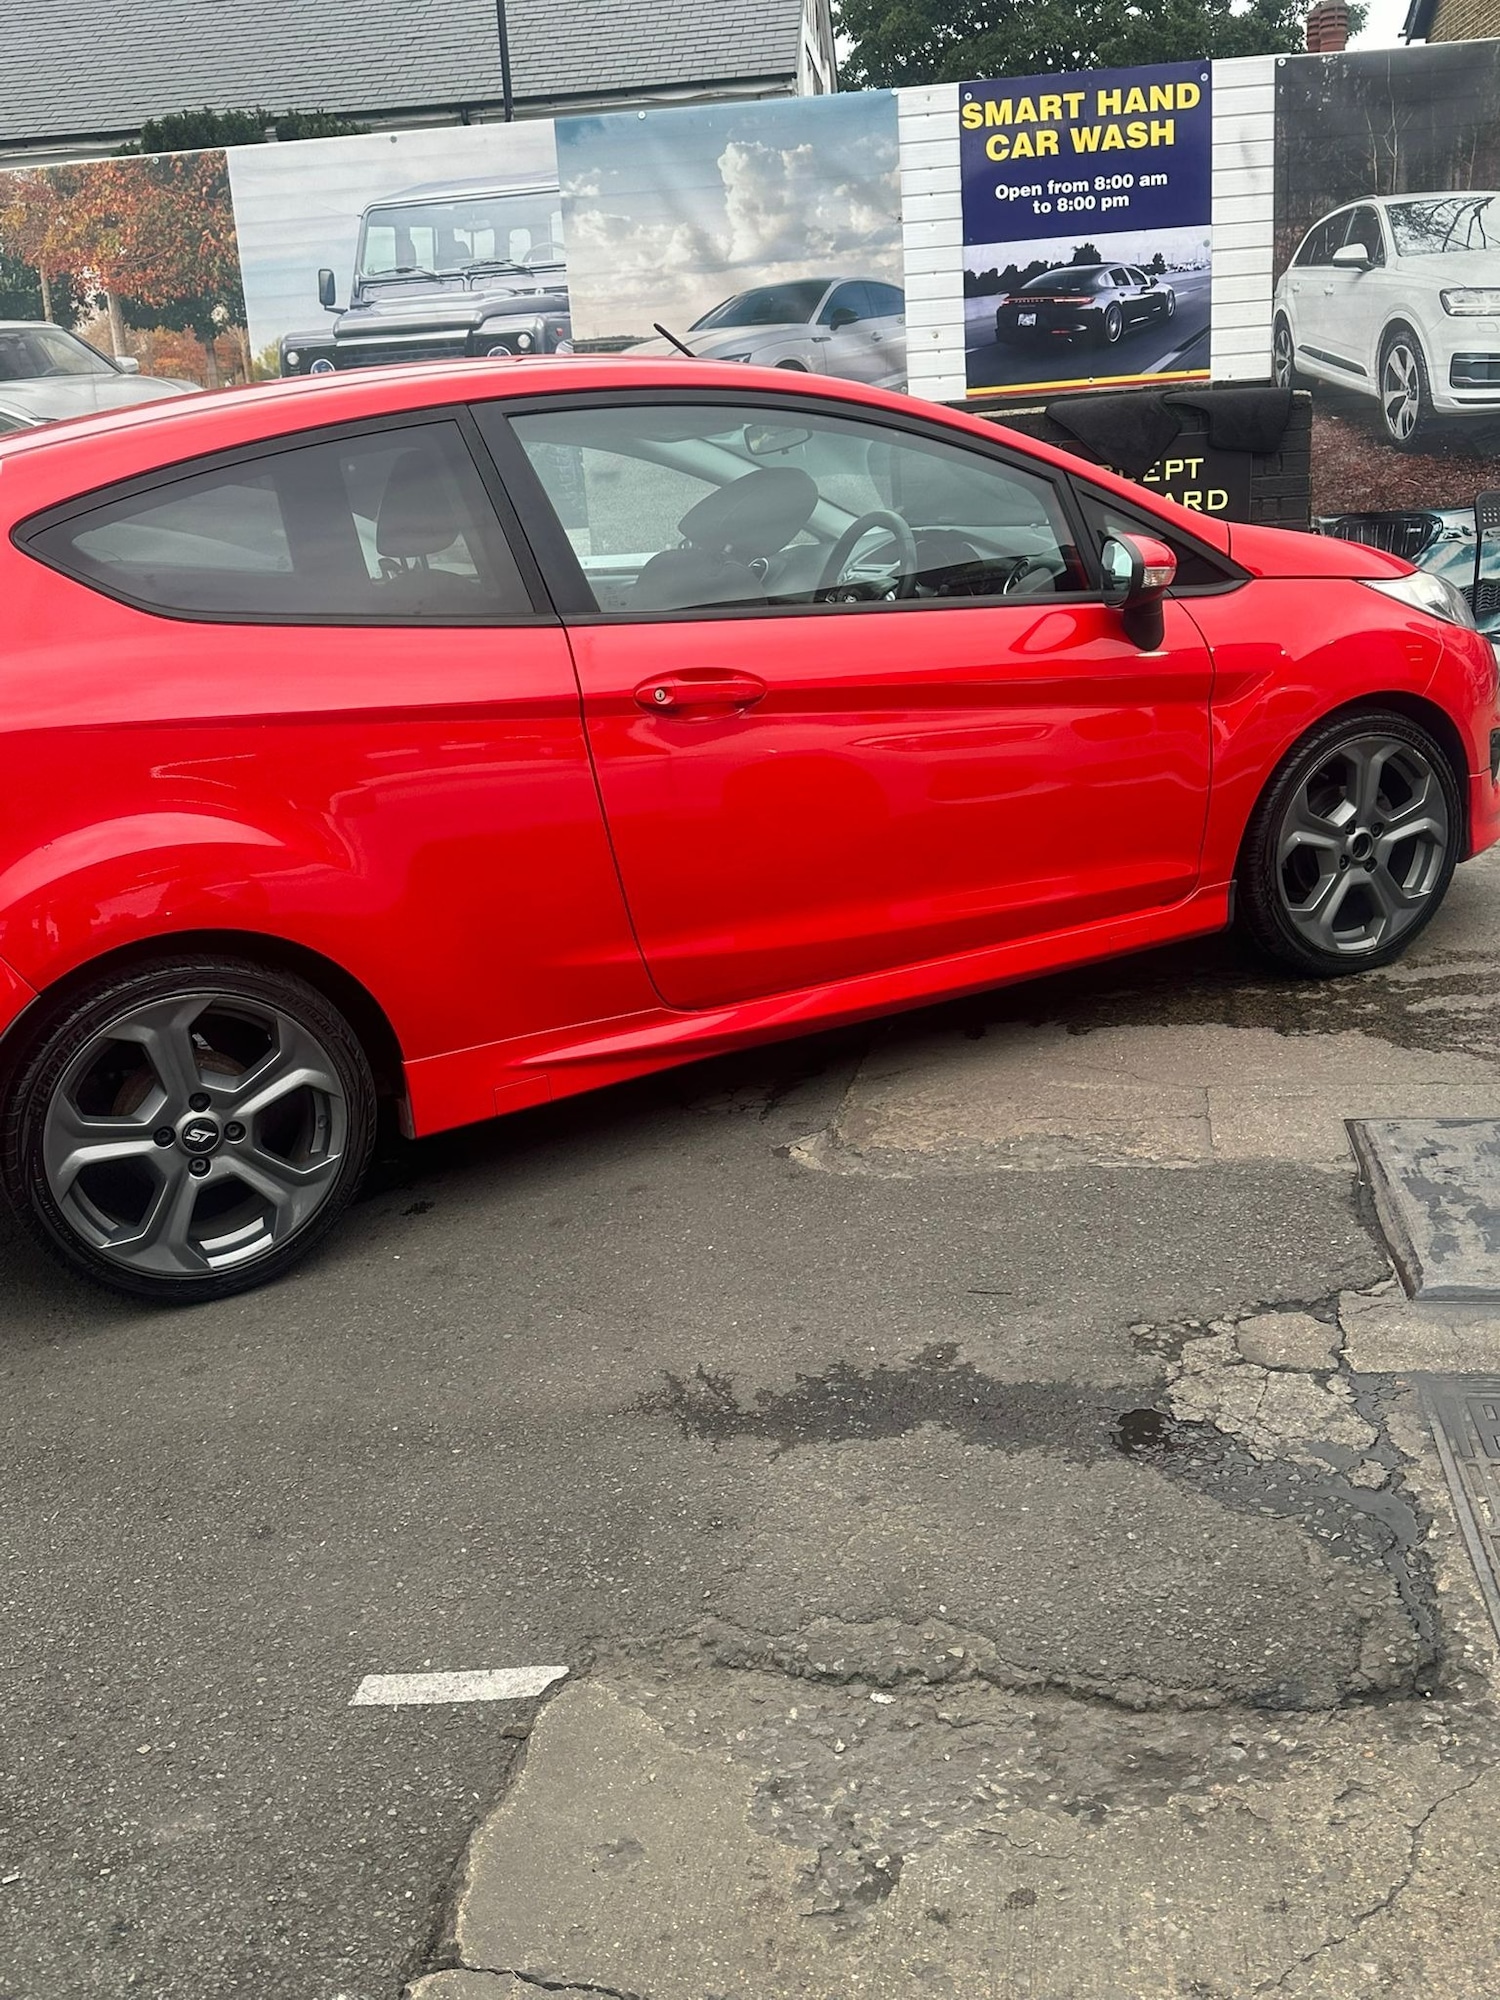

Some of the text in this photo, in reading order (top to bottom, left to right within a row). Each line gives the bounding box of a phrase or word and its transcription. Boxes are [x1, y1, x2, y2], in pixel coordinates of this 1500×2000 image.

[961, 82, 1201, 130] SMART HAND
[985, 118, 1175, 161] CAR WASH
[995, 173, 1168, 201] Open from 8:00 am
[1033, 194, 1129, 214] to 8:00 pm
[185, 1128, 216, 1142] ST
